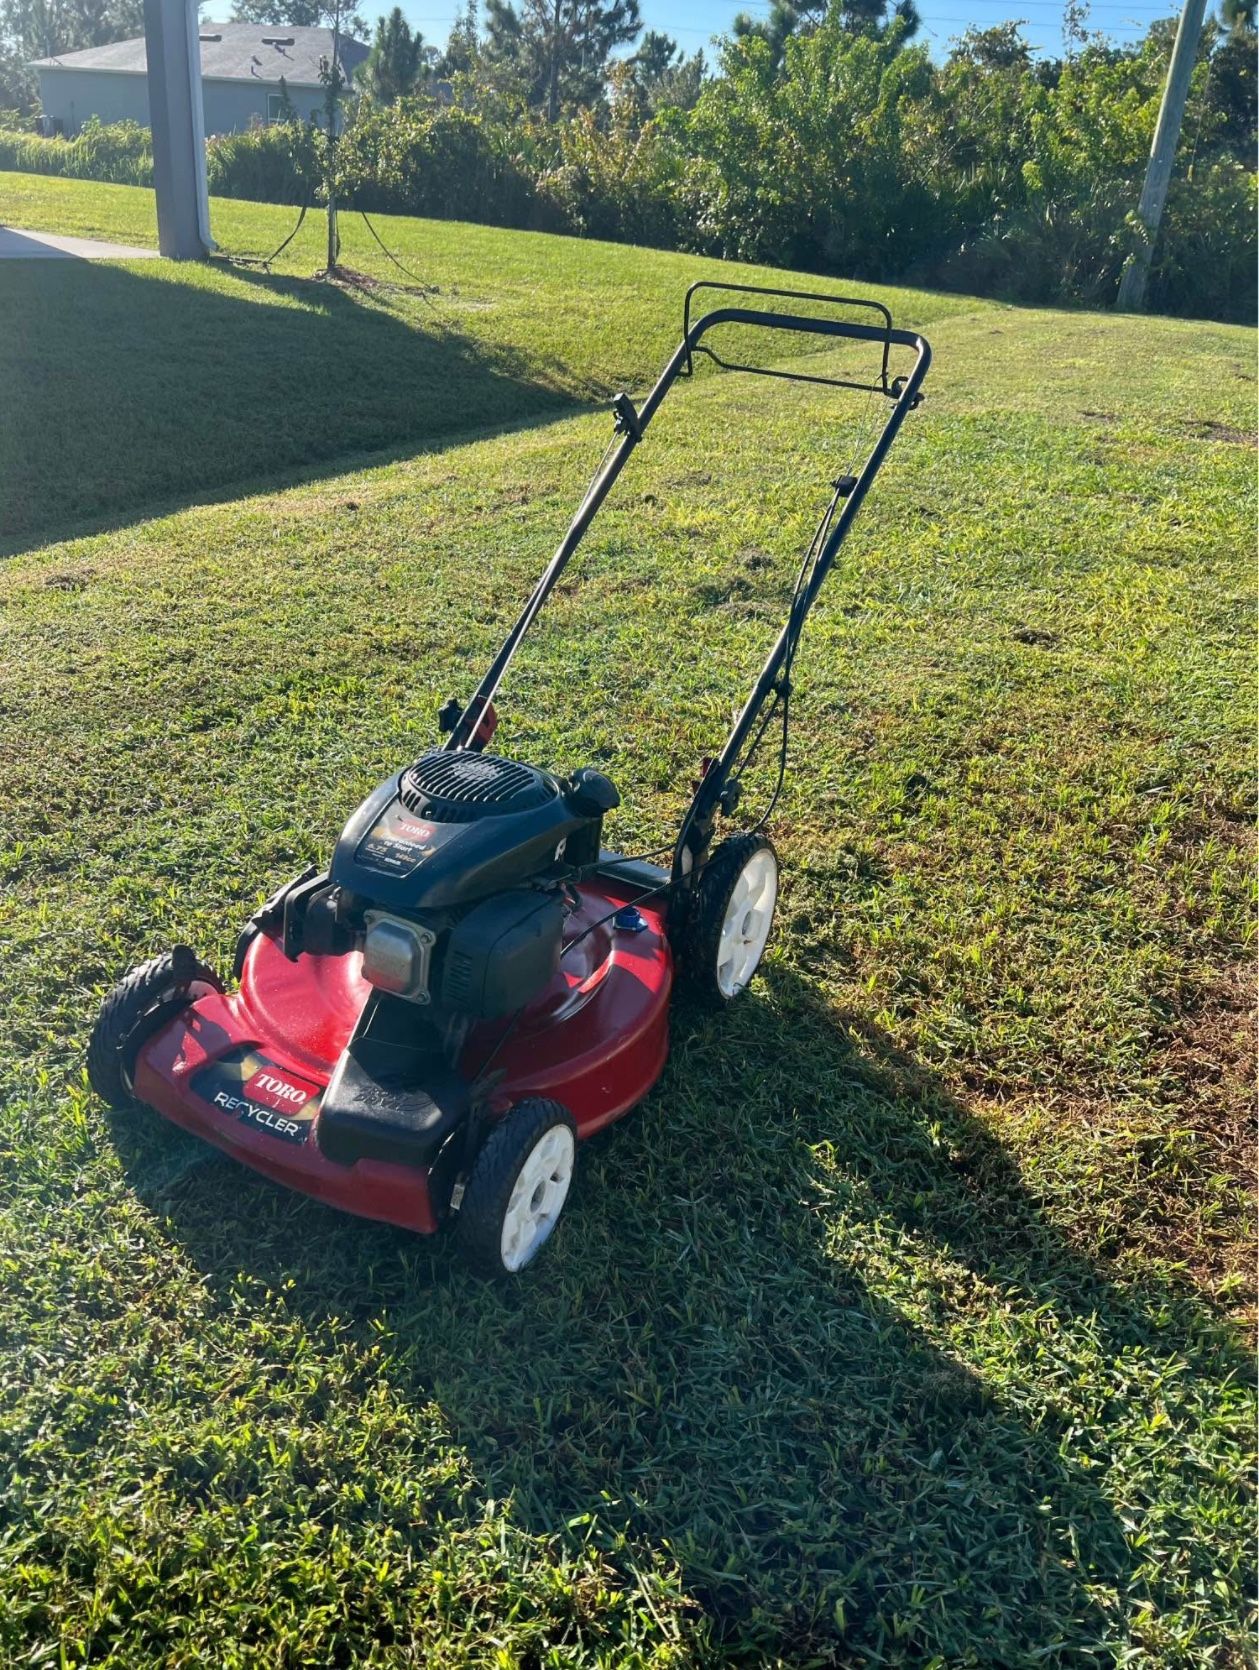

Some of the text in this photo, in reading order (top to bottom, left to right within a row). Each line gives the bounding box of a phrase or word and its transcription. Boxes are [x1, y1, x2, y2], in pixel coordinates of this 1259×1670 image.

[401, 822, 430, 837] TORO
[255, 1073, 307, 1103] TORO
[214, 1092, 299, 1136] RECYCLER
